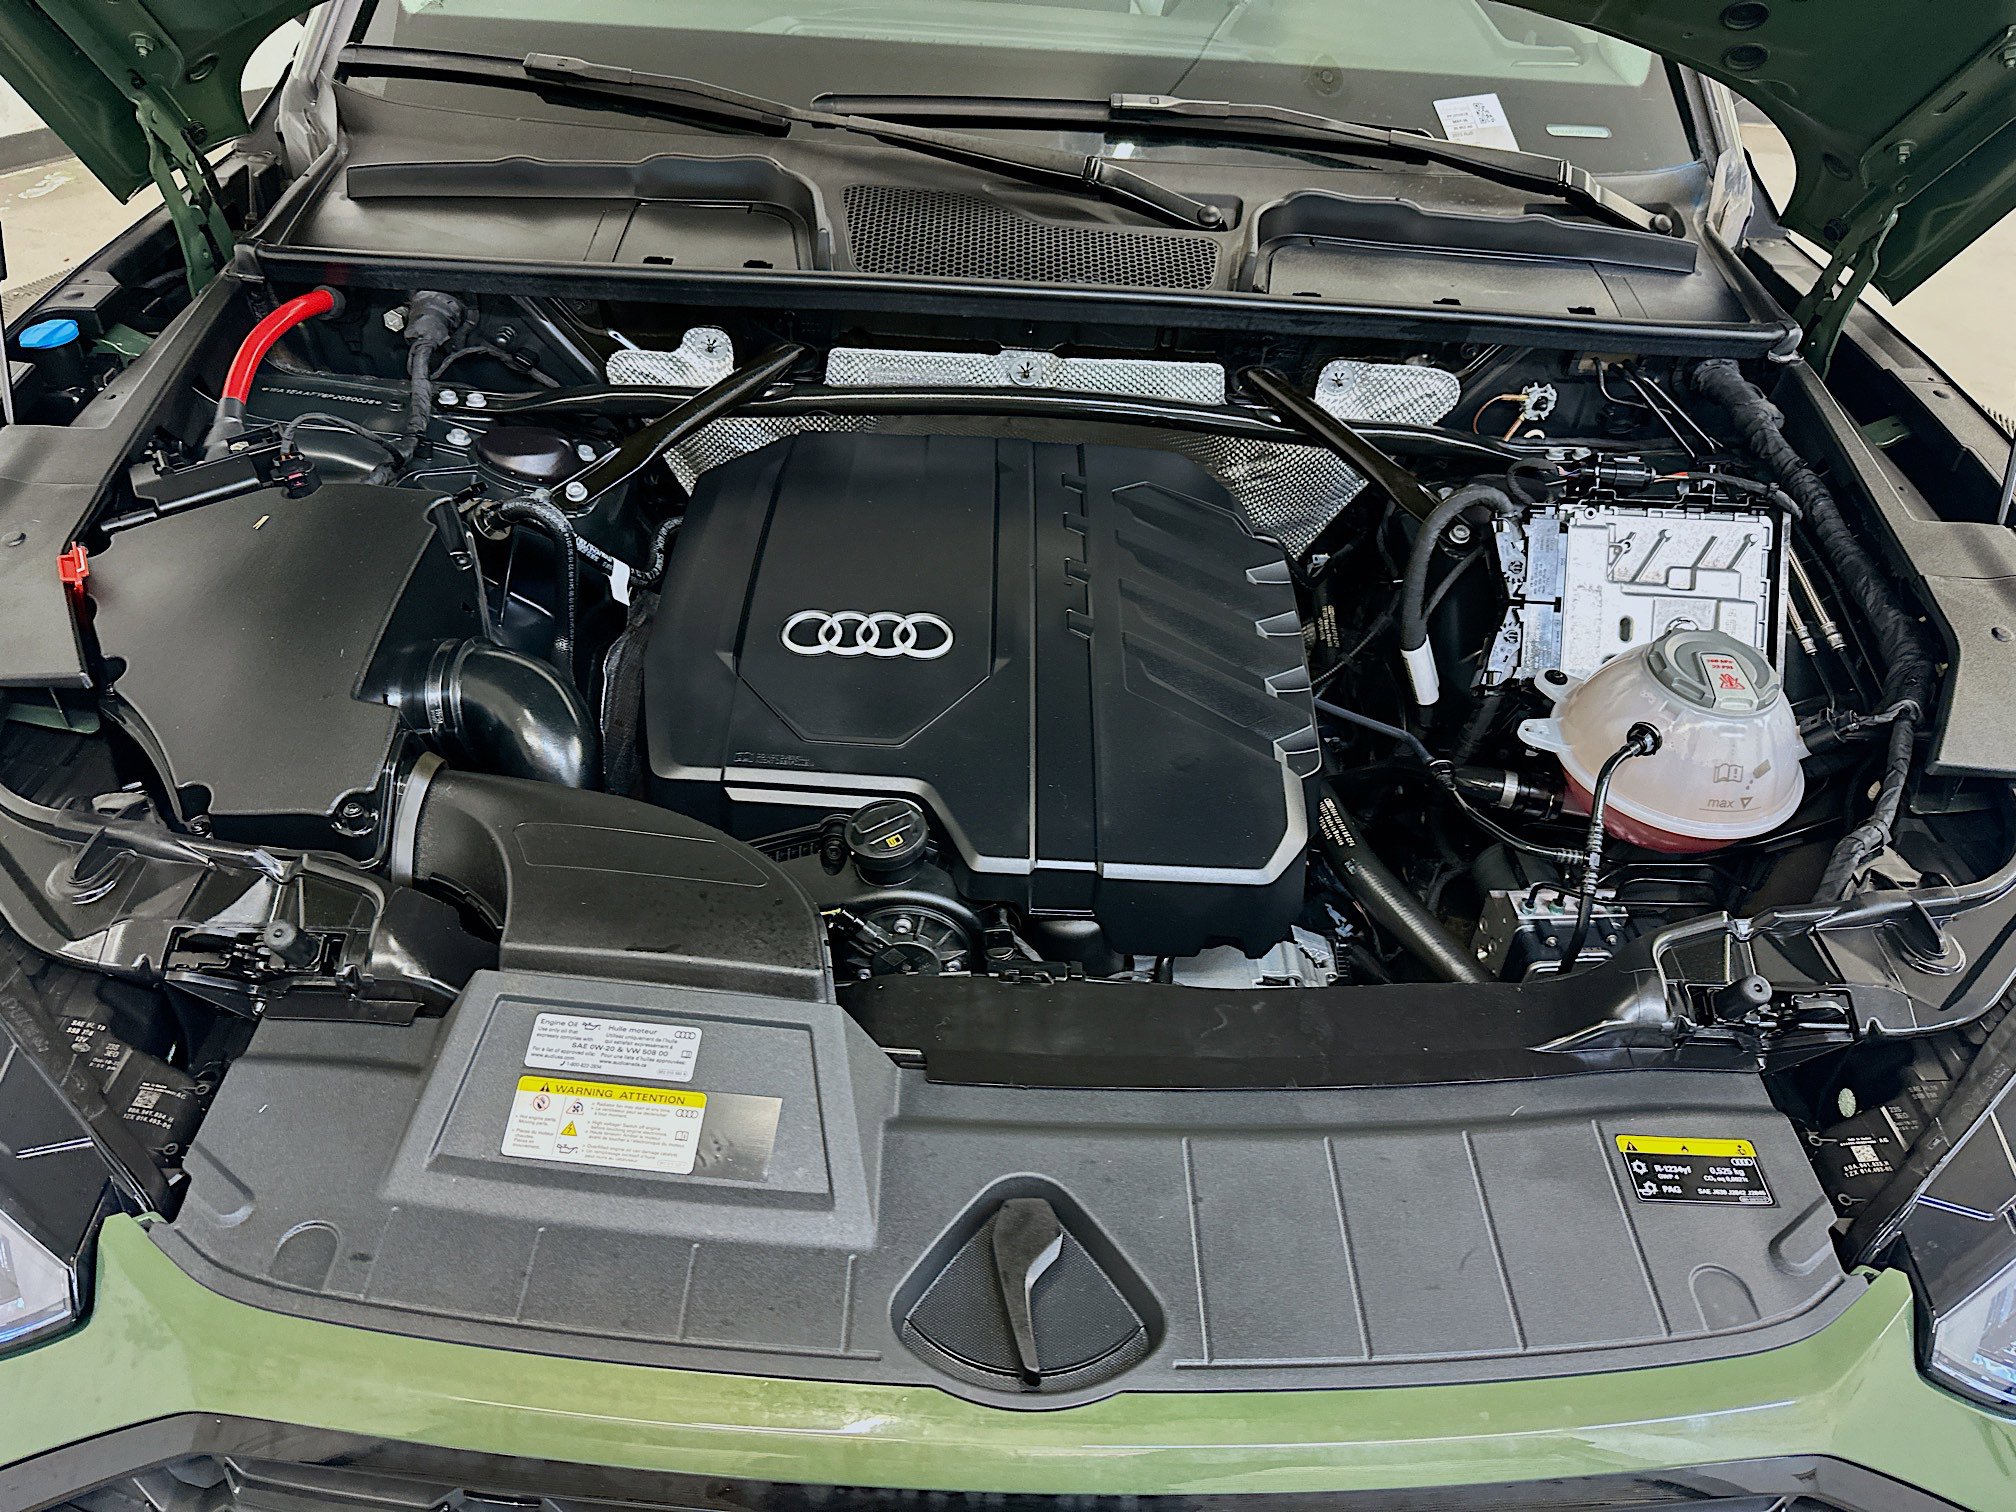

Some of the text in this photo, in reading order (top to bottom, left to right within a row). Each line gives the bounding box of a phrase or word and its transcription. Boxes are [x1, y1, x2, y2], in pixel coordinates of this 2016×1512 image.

[1707, 799, 1734, 808] max
[555, 1084, 685, 1104] WARNING ATTENTION
[1709, 1167, 1733, 1175] 0,525
[1733, 1168, 1746, 1176] kg
[1662, 1185, 1683, 1194] PAG
